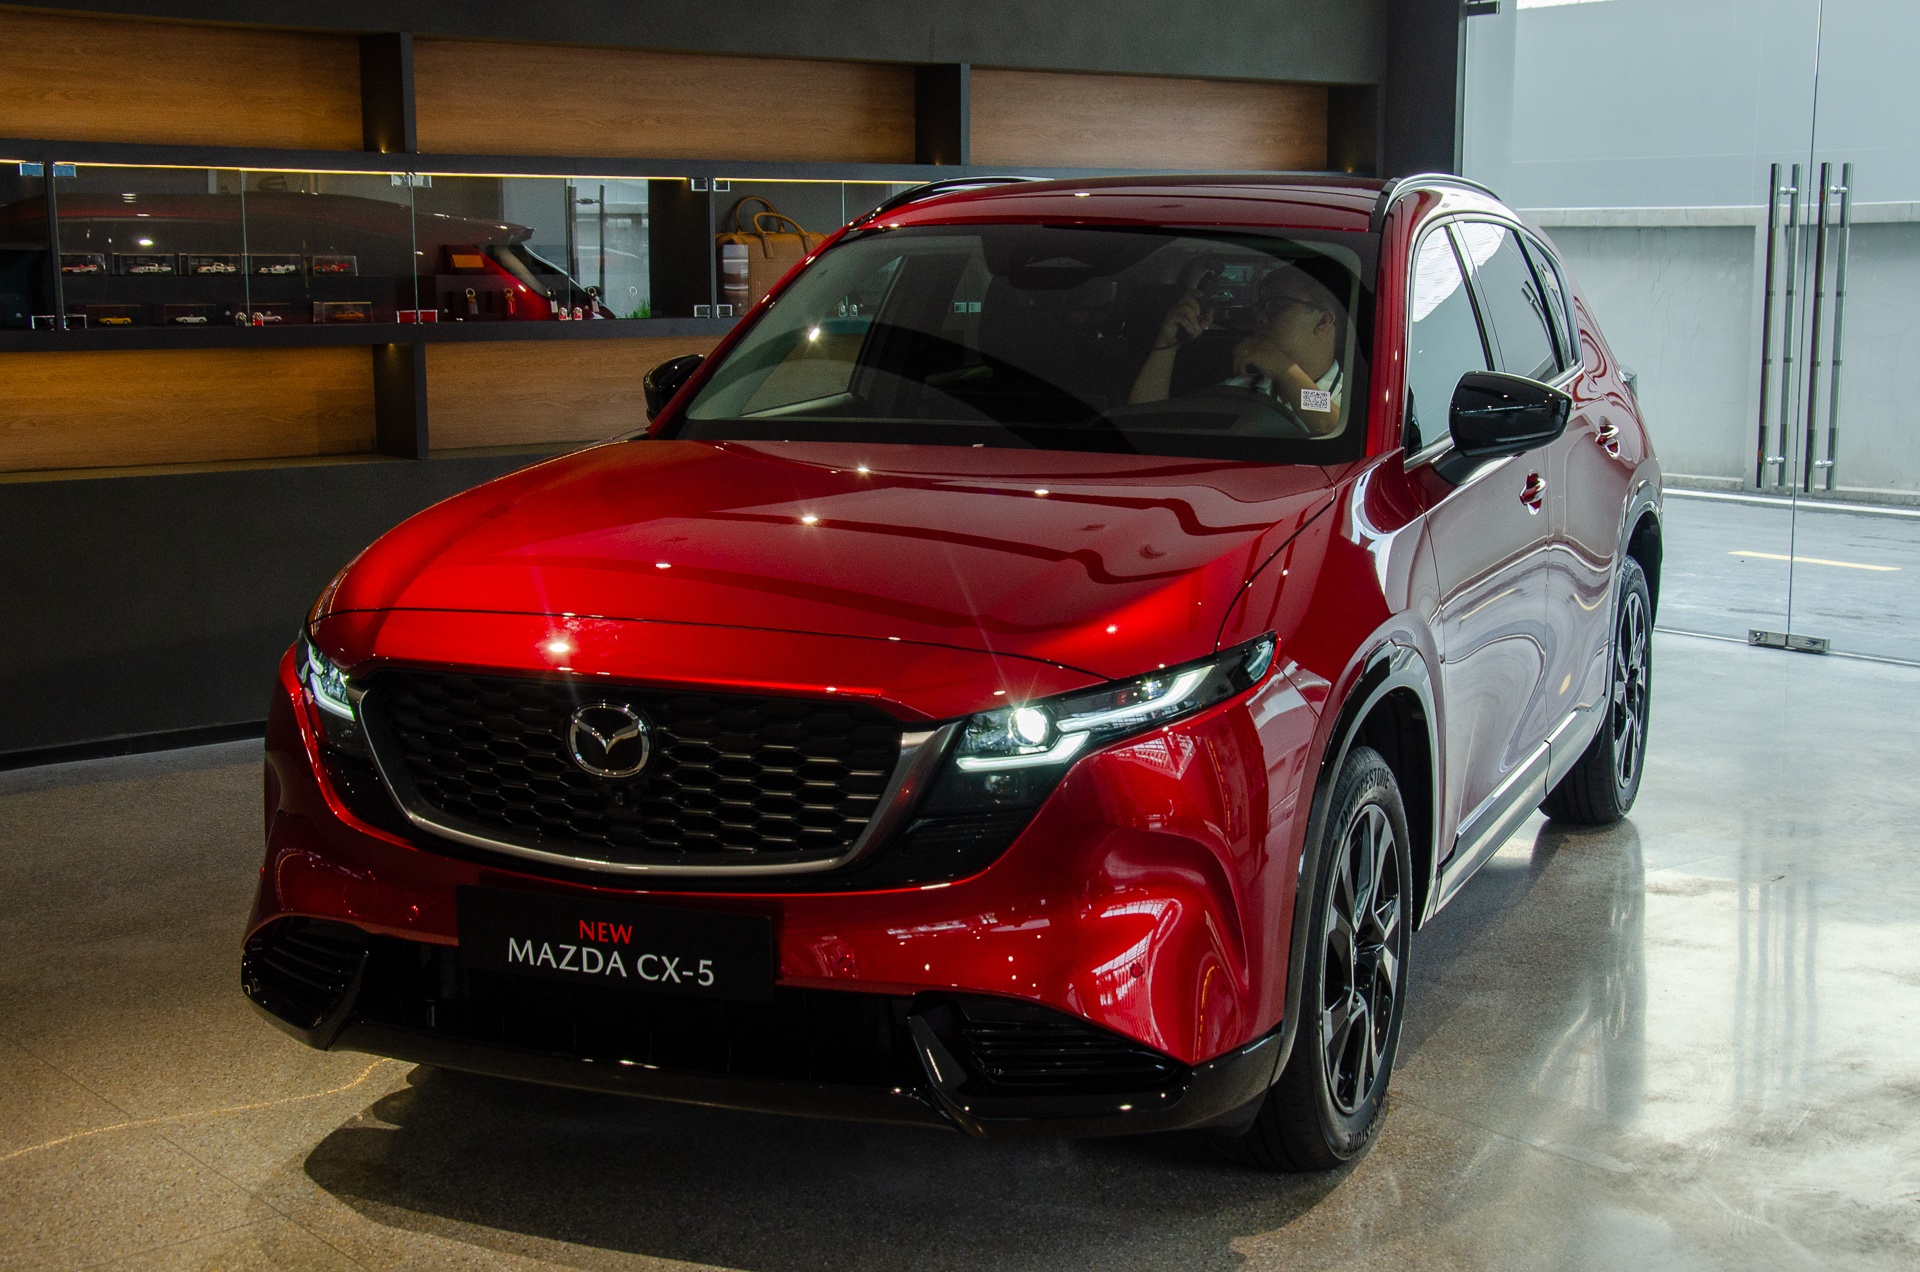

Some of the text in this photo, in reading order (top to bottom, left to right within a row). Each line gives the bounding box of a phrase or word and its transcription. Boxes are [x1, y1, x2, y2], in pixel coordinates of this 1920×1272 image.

[579, 919, 633, 945] NEW
[508, 937, 715, 986] MAZDA CX-5
